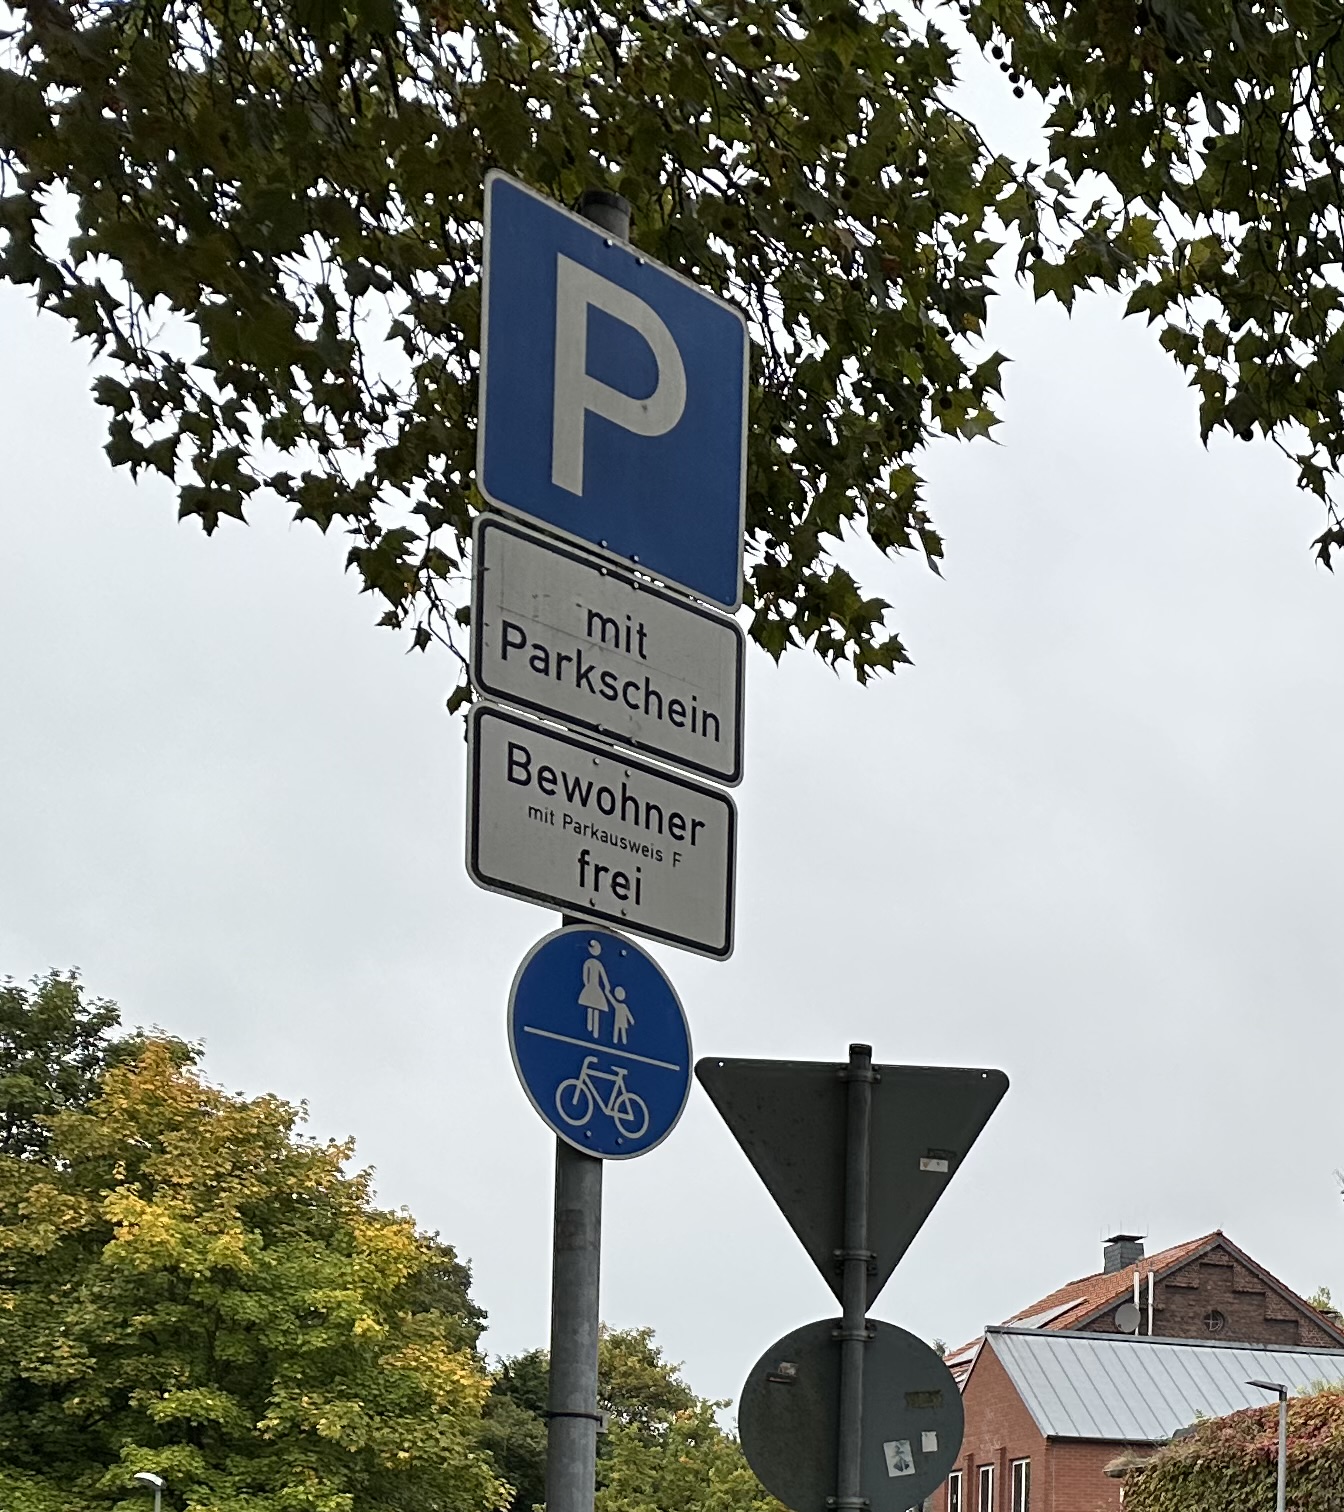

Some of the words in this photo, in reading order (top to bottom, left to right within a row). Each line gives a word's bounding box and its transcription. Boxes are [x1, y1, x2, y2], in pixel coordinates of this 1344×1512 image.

[551, 250, 689, 497] P
[586, 608, 648, 660] mit
[500, 619, 721, 743] Parkschein
[506, 741, 706, 847] Bewohner
[527, 804, 555, 826] mit
[562, 813, 664, 863] Parkausweis
[672, 851, 683, 868] F
[577, 849, 643, 905] frei
